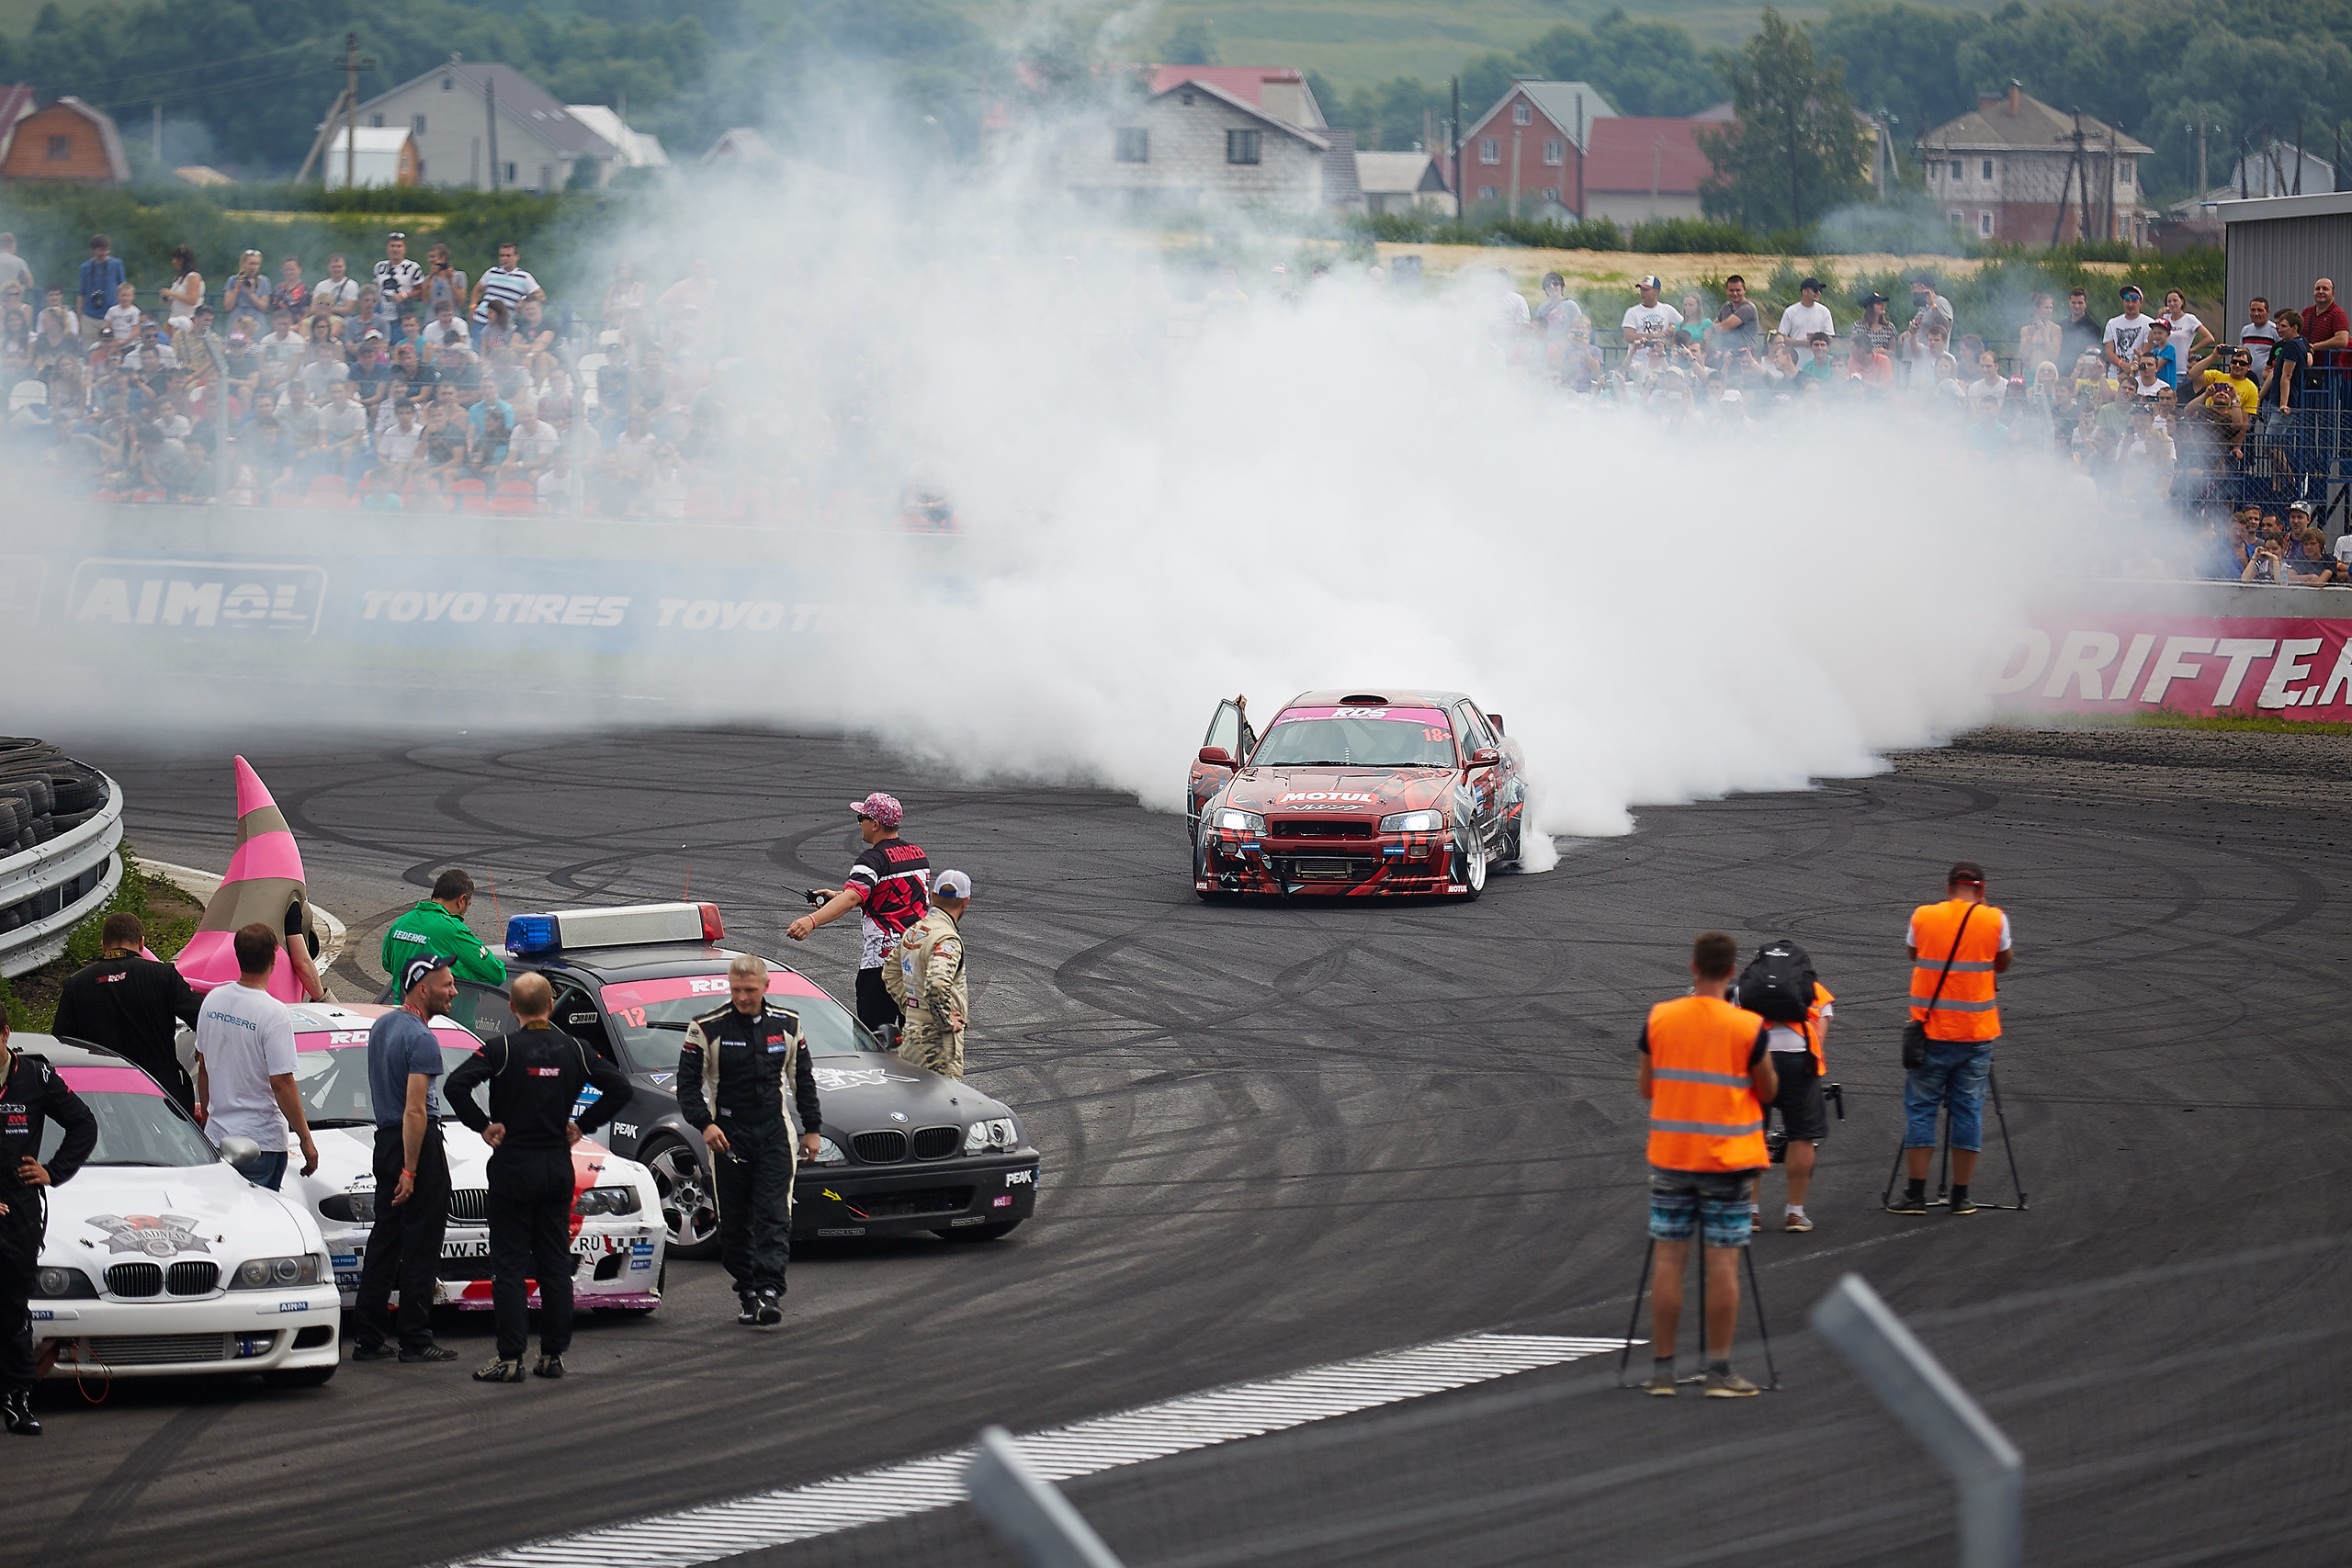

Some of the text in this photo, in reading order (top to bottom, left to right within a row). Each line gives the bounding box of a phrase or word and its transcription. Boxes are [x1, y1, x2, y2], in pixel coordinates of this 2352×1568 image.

[75, 578, 309, 630] AIMOL
[362, 590, 631, 626] TOYO TIRES
[656, 597, 786, 631] TOYO
[1330, 706, 1391, 718] RDS
[1421, 728, 1452, 742] 18+
[1280, 792, 1373, 803] MOTUL
[1448, 885, 1467, 893] MOTUL
[392, 930, 427, 944] FEDERAL
[689, 978, 731, 994] RD
[206, 1010, 256, 1032] NORDBERG
[619, 1006, 648, 1028] 12
[329, 1031, 369, 1045] RD
[613, 1122, 639, 1139] PEAK
[1005, 1169, 1033, 1188] PEAK
[136, 1230, 187, 1240] MADNESS
